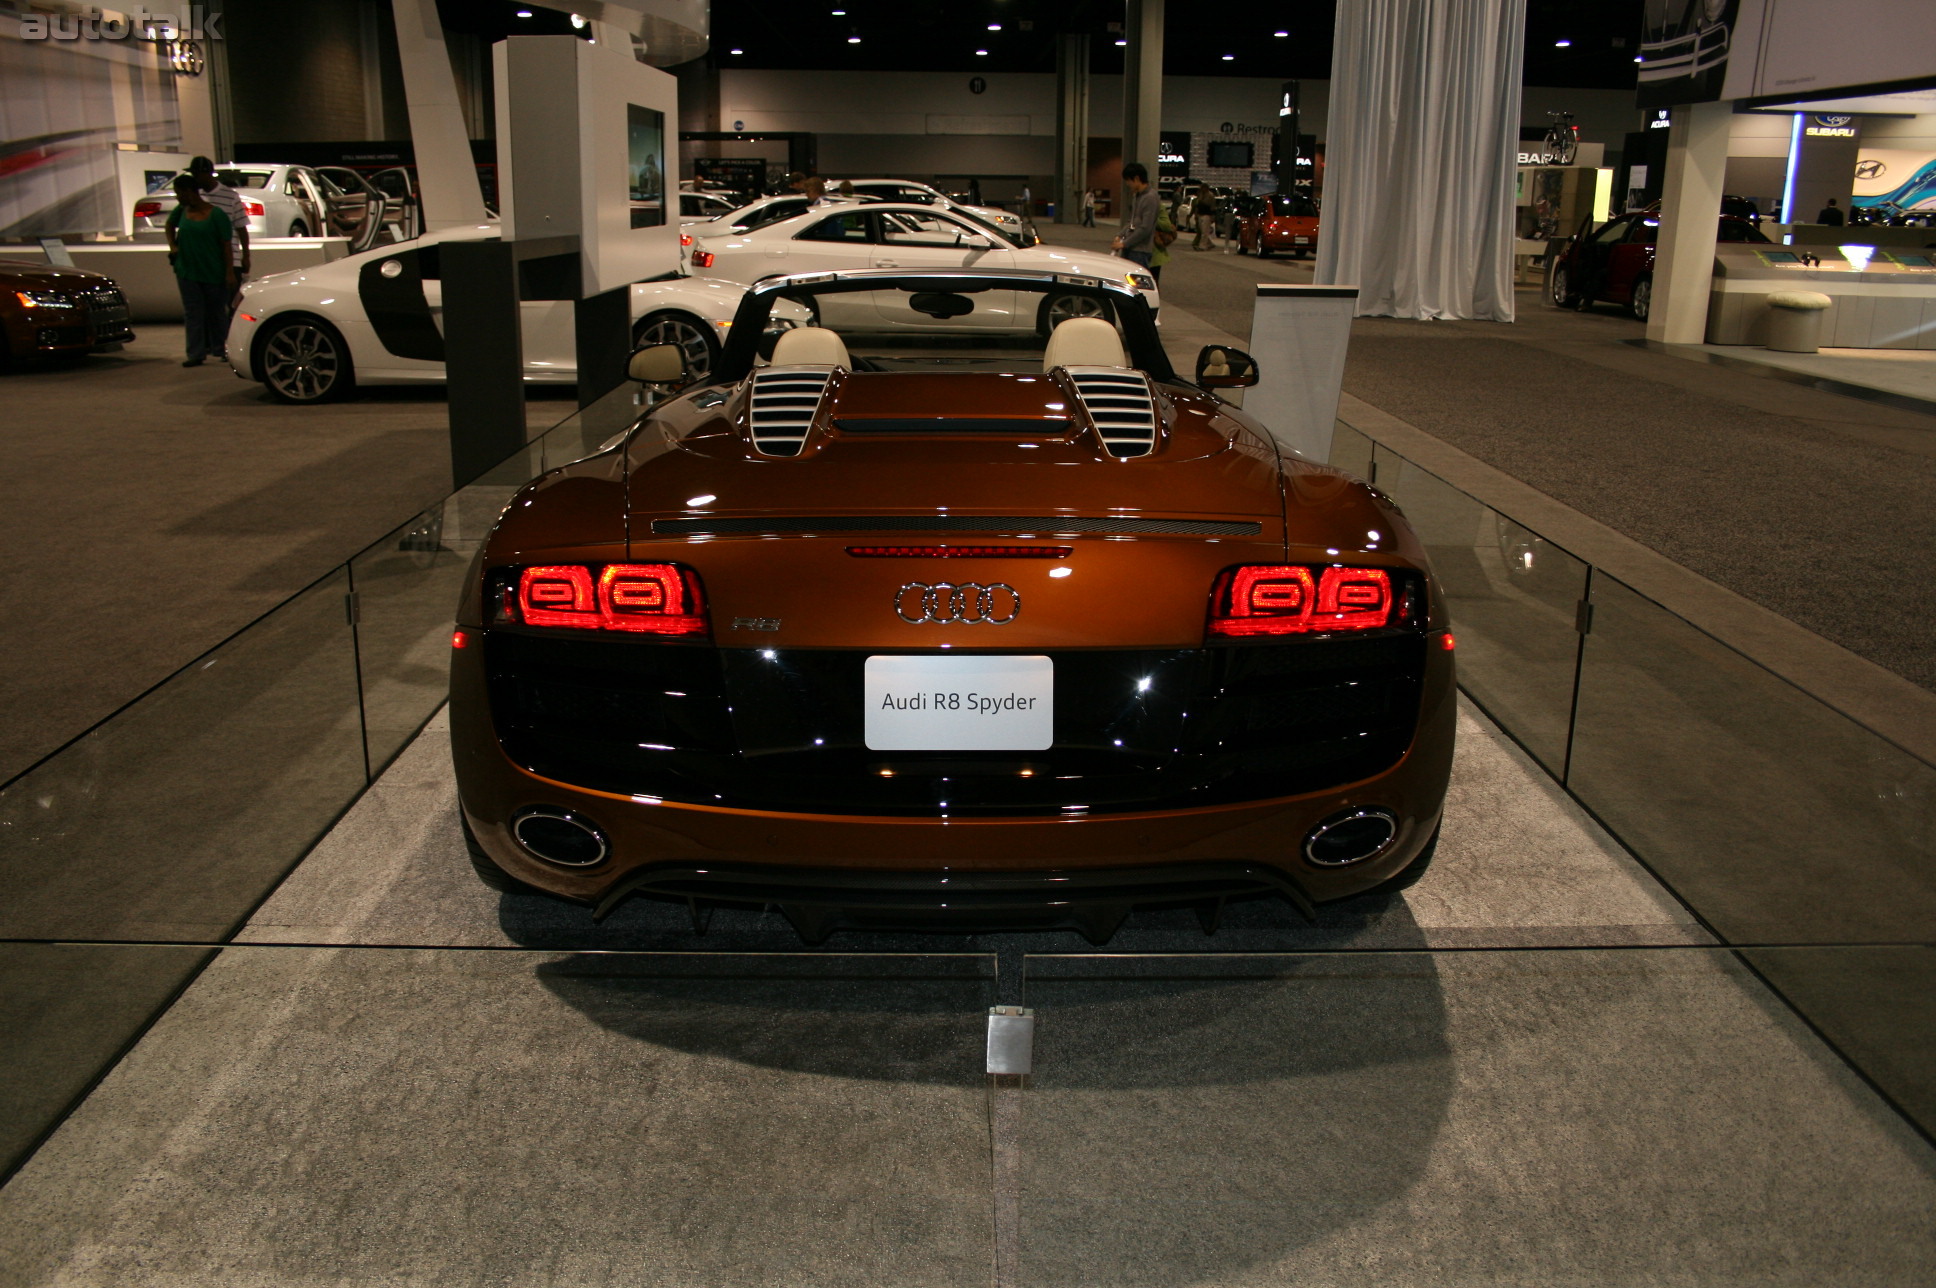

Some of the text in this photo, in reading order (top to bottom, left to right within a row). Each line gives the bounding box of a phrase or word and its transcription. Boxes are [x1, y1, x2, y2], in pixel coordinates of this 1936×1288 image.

[1237, 122, 1281, 135] Restroo
[1651, 120, 1670, 129] ACURA
[1806, 127, 1855, 138] SUBARU
[1158, 154, 1185, 163] CURA
[881, 692, 1037, 715] Audi R8 Spyder
